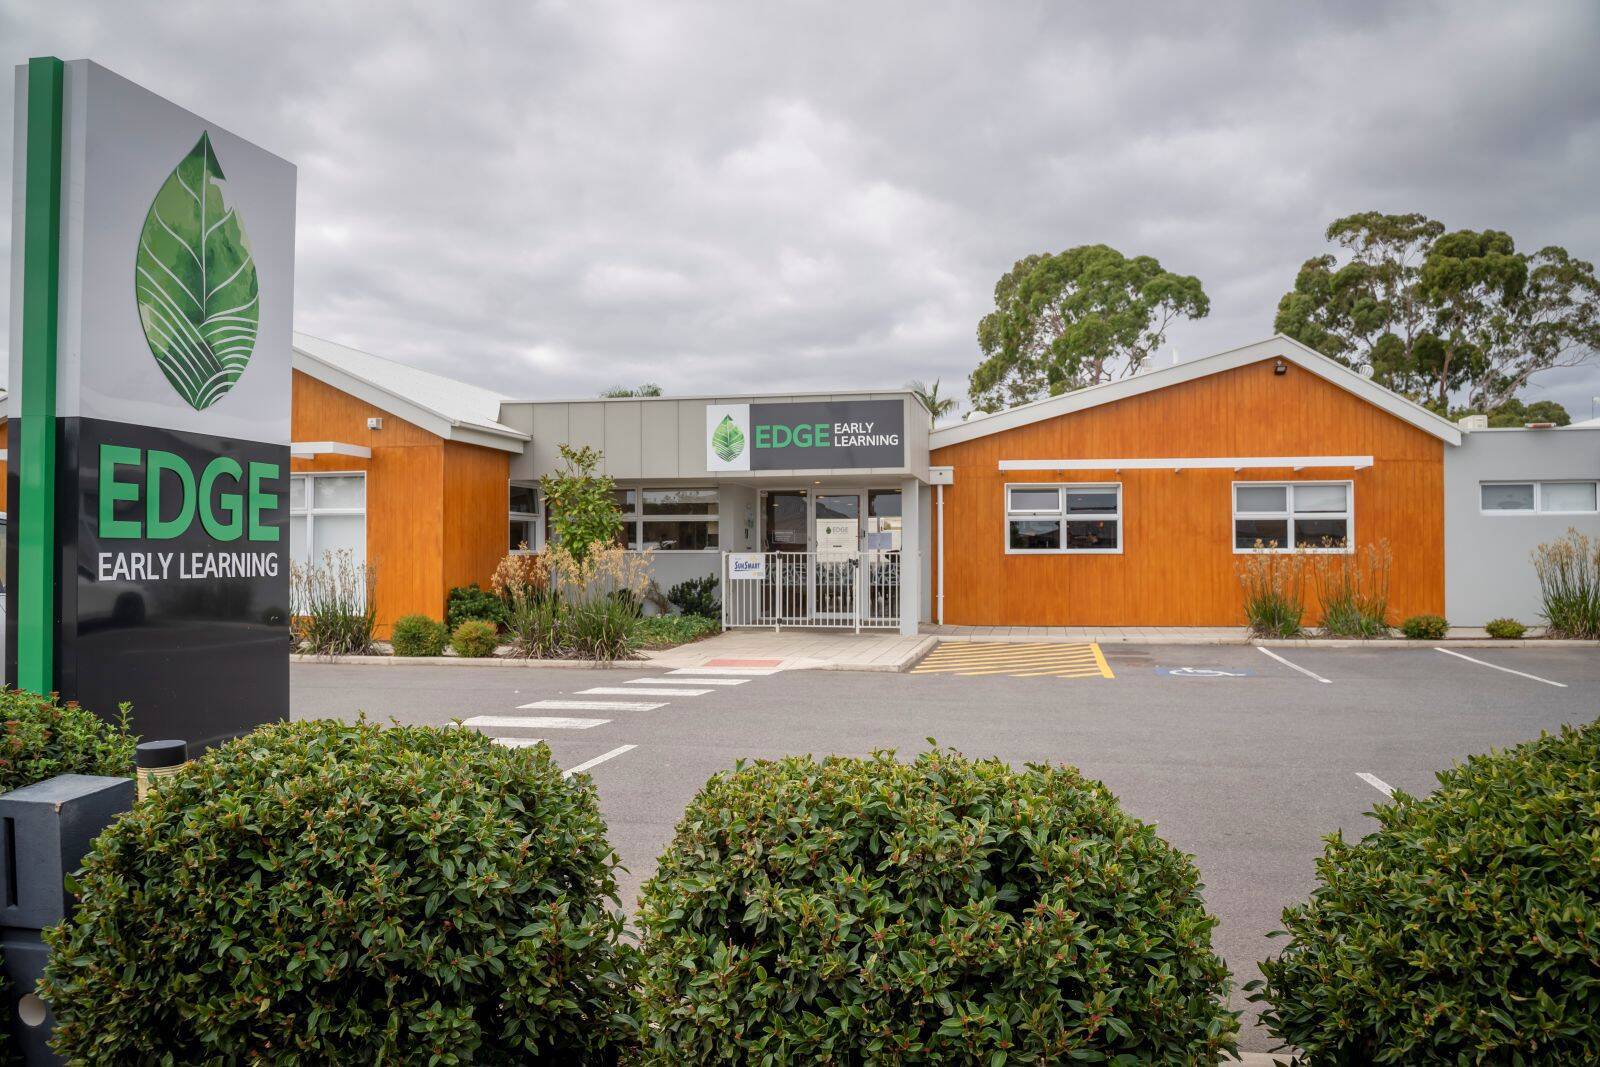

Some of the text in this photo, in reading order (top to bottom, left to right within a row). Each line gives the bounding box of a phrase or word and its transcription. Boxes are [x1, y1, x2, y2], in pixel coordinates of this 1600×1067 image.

[755, 423, 830, 449] EDGE
[834, 422, 874, 434] EARLY
[834, 434, 899, 447] LEARNING
[99, 443, 280, 542] EDGE
[98, 552, 278, 581] EARLY LEARNING
